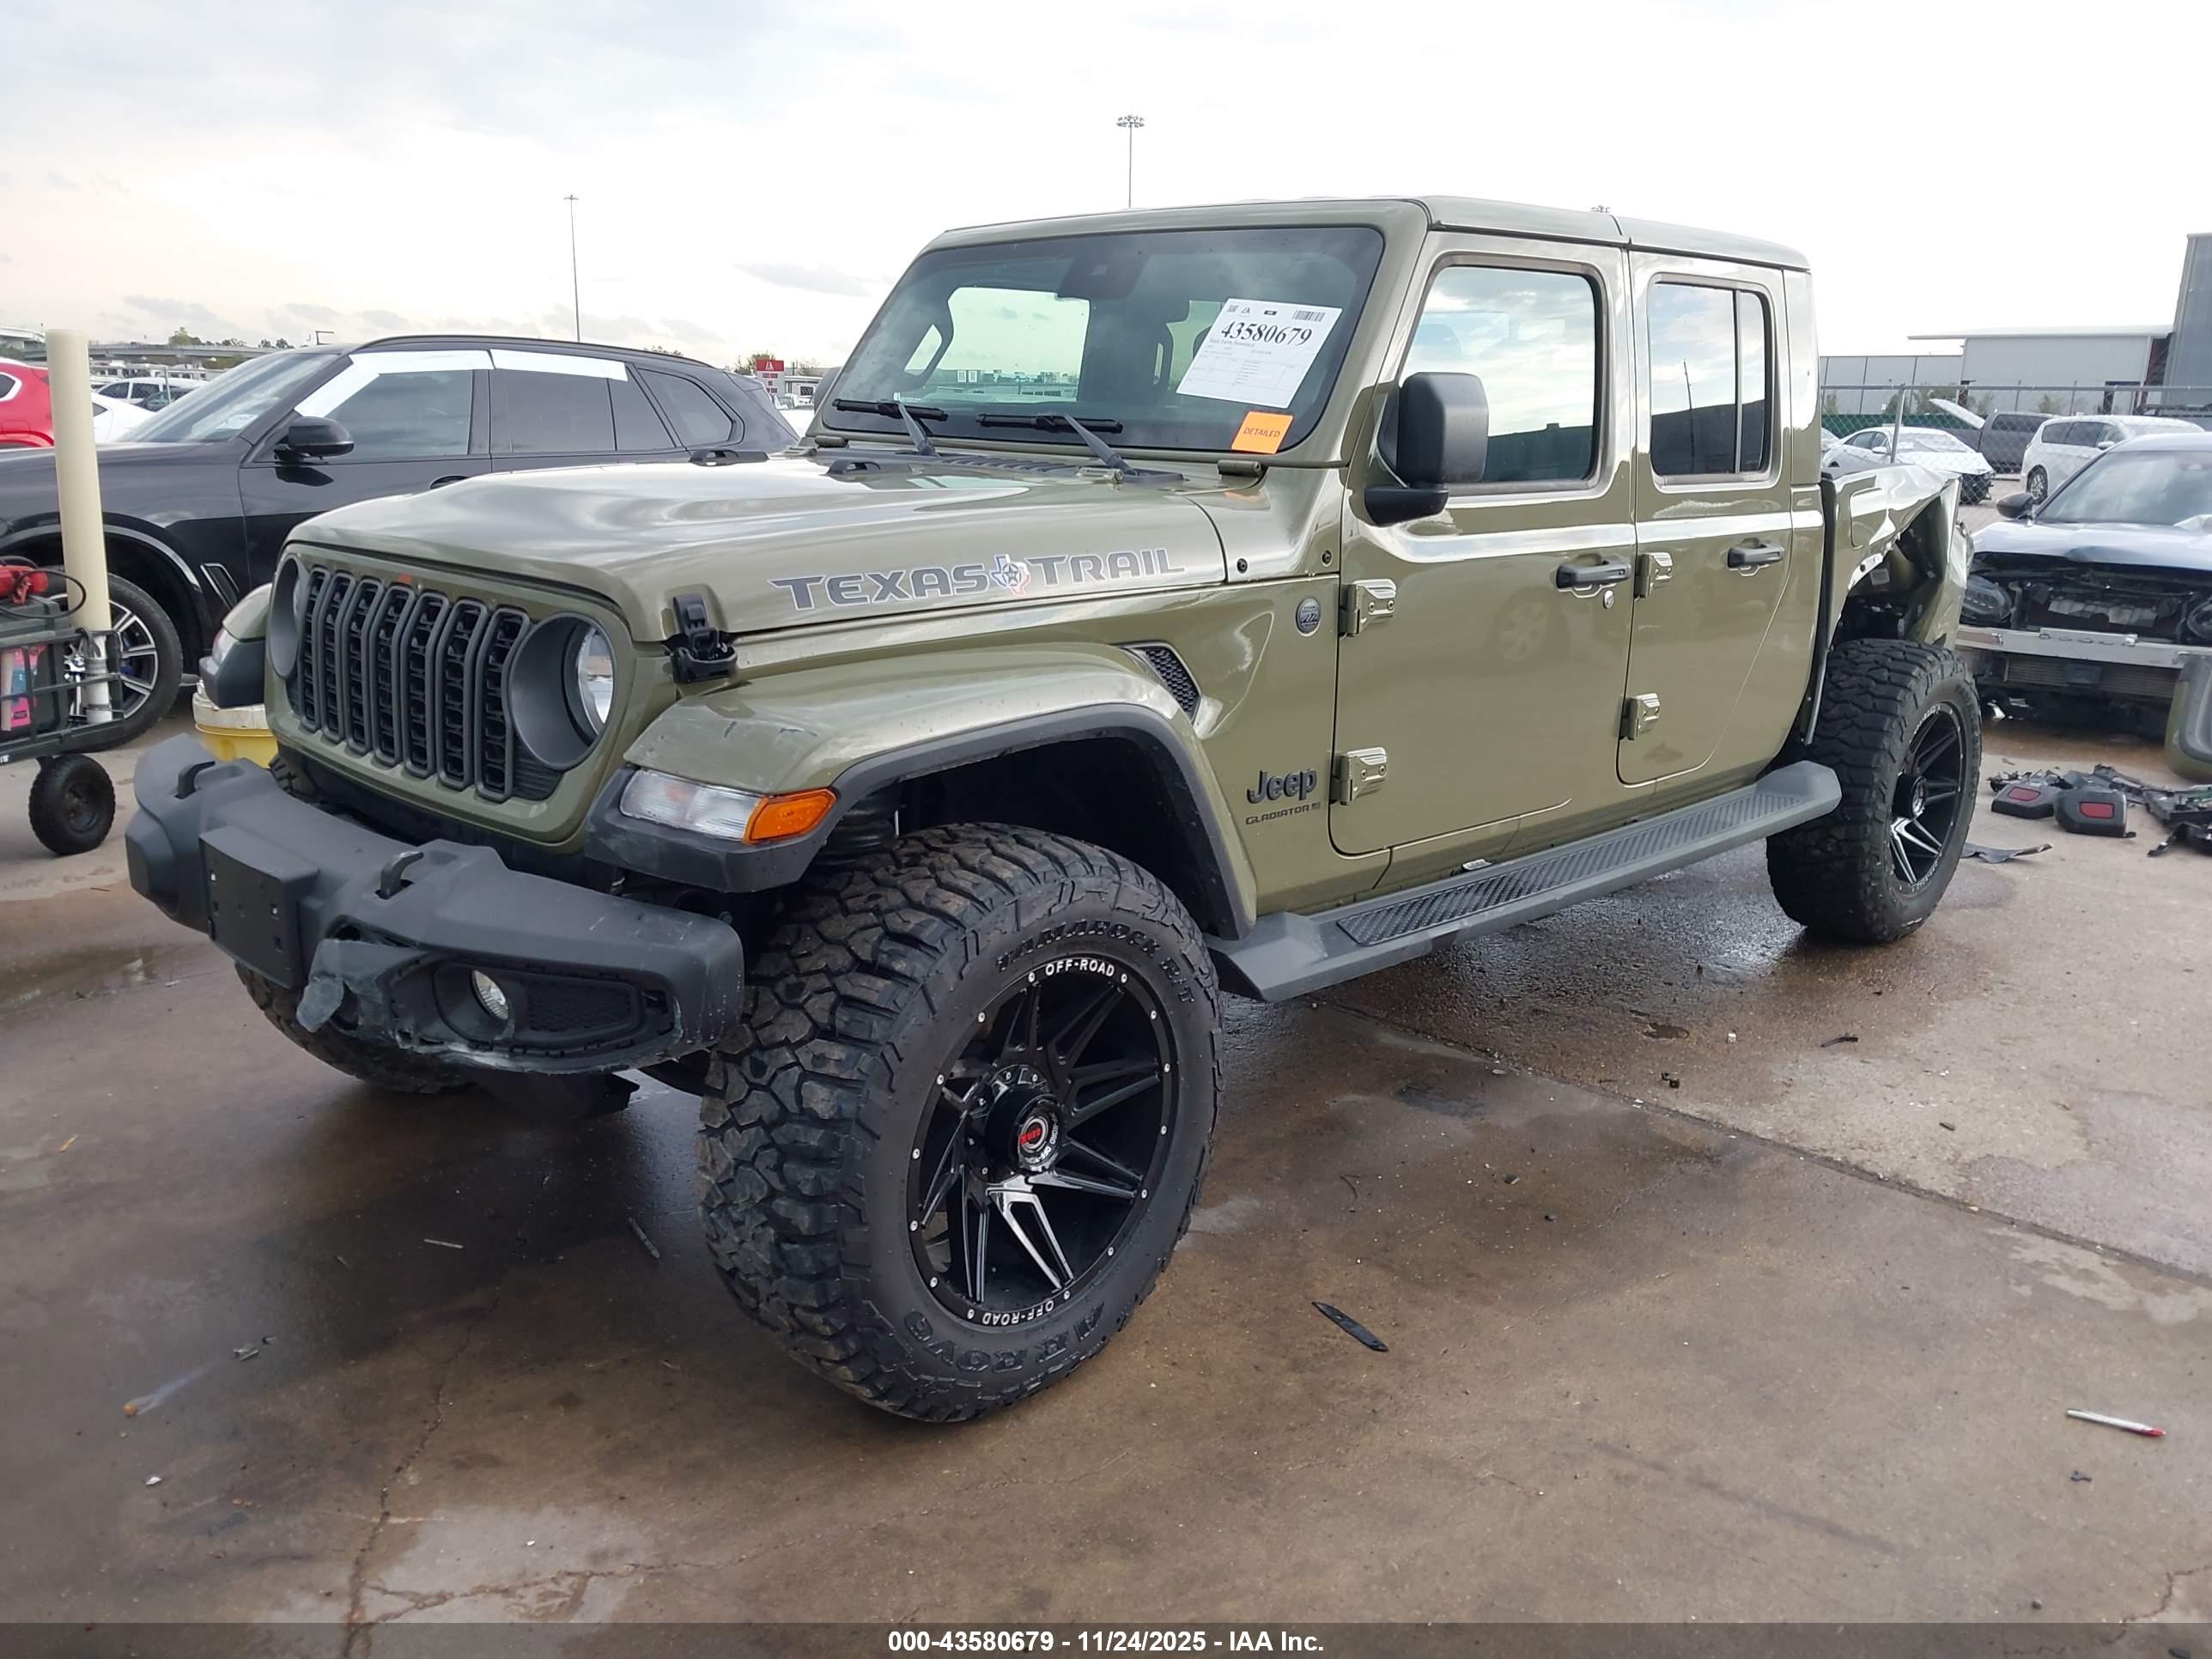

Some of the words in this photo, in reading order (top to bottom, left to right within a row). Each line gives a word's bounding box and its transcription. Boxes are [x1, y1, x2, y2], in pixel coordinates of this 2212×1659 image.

[1221, 321, 1313, 347] 43580679
[1243, 427, 1280, 438] DETAILED
[769, 563, 989, 611] TEXAS
[1026, 548, 1186, 586] TRAIL
[1246, 769, 1317, 805] Jeep
[1245, 804, 1310, 825] GLADIATOR
[1045, 957, 1115, 977] OFF-ROAD
[981, 1299, 1055, 1327] OFF-ROAD
